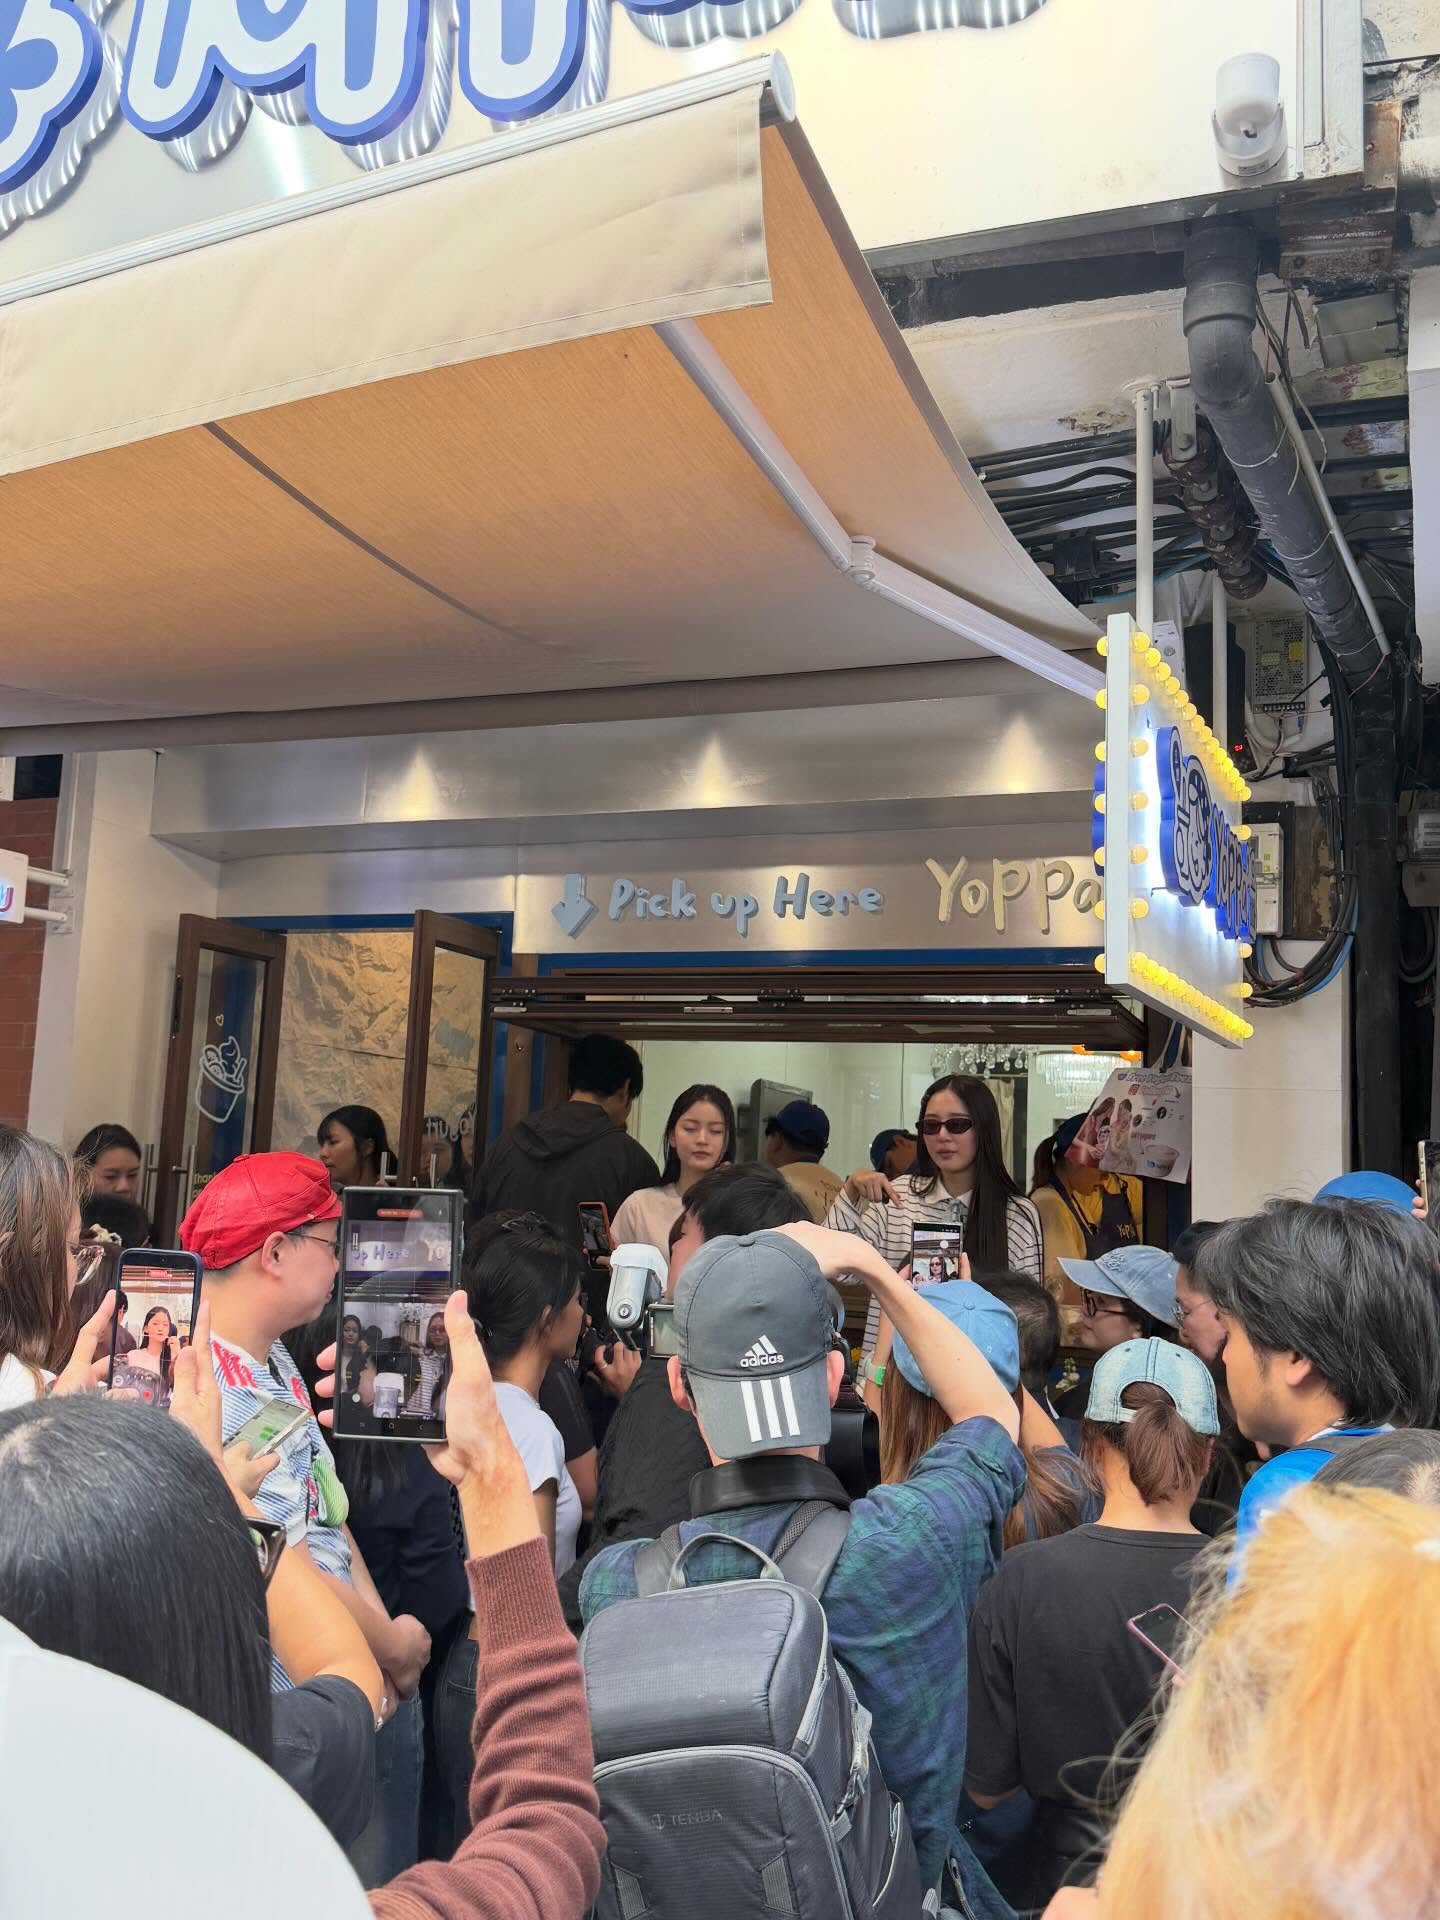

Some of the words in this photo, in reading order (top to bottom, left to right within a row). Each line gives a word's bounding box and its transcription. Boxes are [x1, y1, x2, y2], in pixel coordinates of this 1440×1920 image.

[608, 878, 697, 920] Pick
[711, 890, 759, 937] up
[773, 872, 884, 920] Here
[374, 1243, 410, 1261] Here
[740, 1352, 785, 1368] adidas
